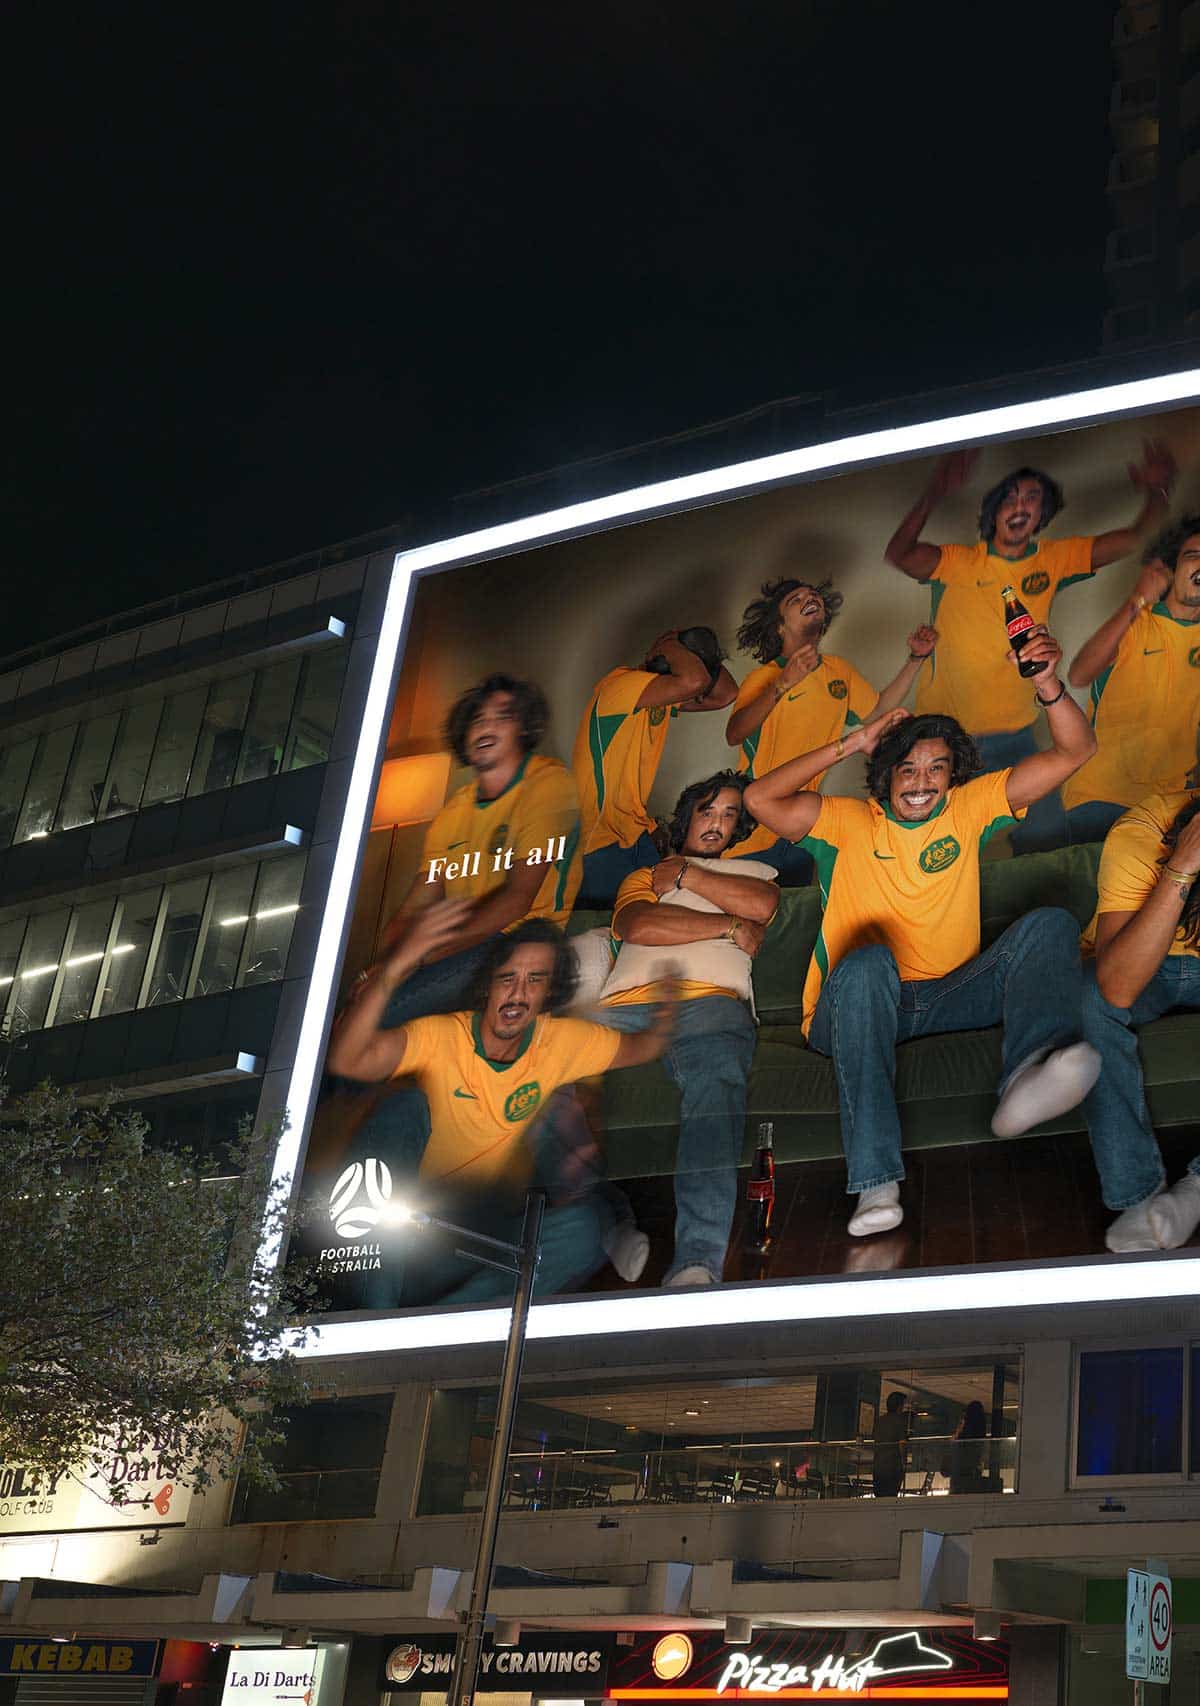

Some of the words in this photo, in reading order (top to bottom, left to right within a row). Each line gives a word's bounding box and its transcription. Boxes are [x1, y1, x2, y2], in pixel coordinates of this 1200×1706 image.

[425, 851, 481, 884] Fell
[492, 847, 514, 872] it
[526, 836, 566, 866] all
[320, 1243, 382, 1260] FOOTBALL
[1153, 1601, 1168, 1632] 40
[9, 1644, 134, 1672] KEBAB
[421, 1652, 495, 1674] SMY
[496, 1650, 601, 1674] CRAVINGS
[1149, 1655, 1169, 1677] AREA
[230, 1672, 249, 1687] La
[253, 1672, 271, 1687] Di
[273, 1672, 317, 1687] Darts
[716, 1652, 809, 1694] Pizza
[811, 1654, 884, 1692] Hut
